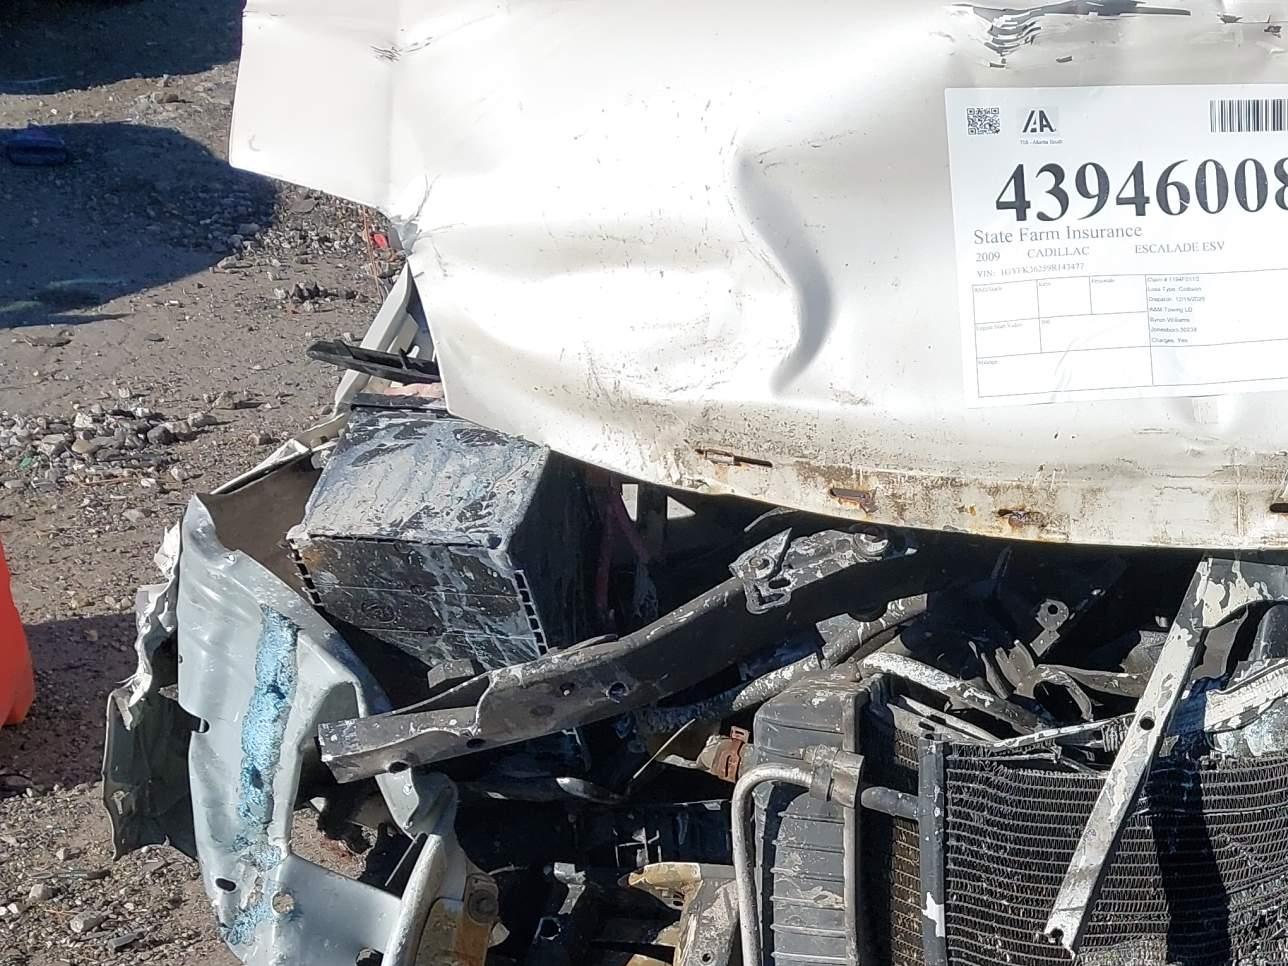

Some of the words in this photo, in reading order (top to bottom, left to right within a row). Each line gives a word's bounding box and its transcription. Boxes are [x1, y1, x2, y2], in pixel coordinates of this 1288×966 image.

[974, 229, 1013, 244] State
[1019, 227, 1060, 242] Farm
[1066, 226, 1143, 240] Insurance
[976, 251, 1001, 263] 2009
[1027, 246, 1090, 259] CADILLAC
[1135, 242, 1199, 254] ESCALADE
[1202, 240, 1225, 252] ESV
